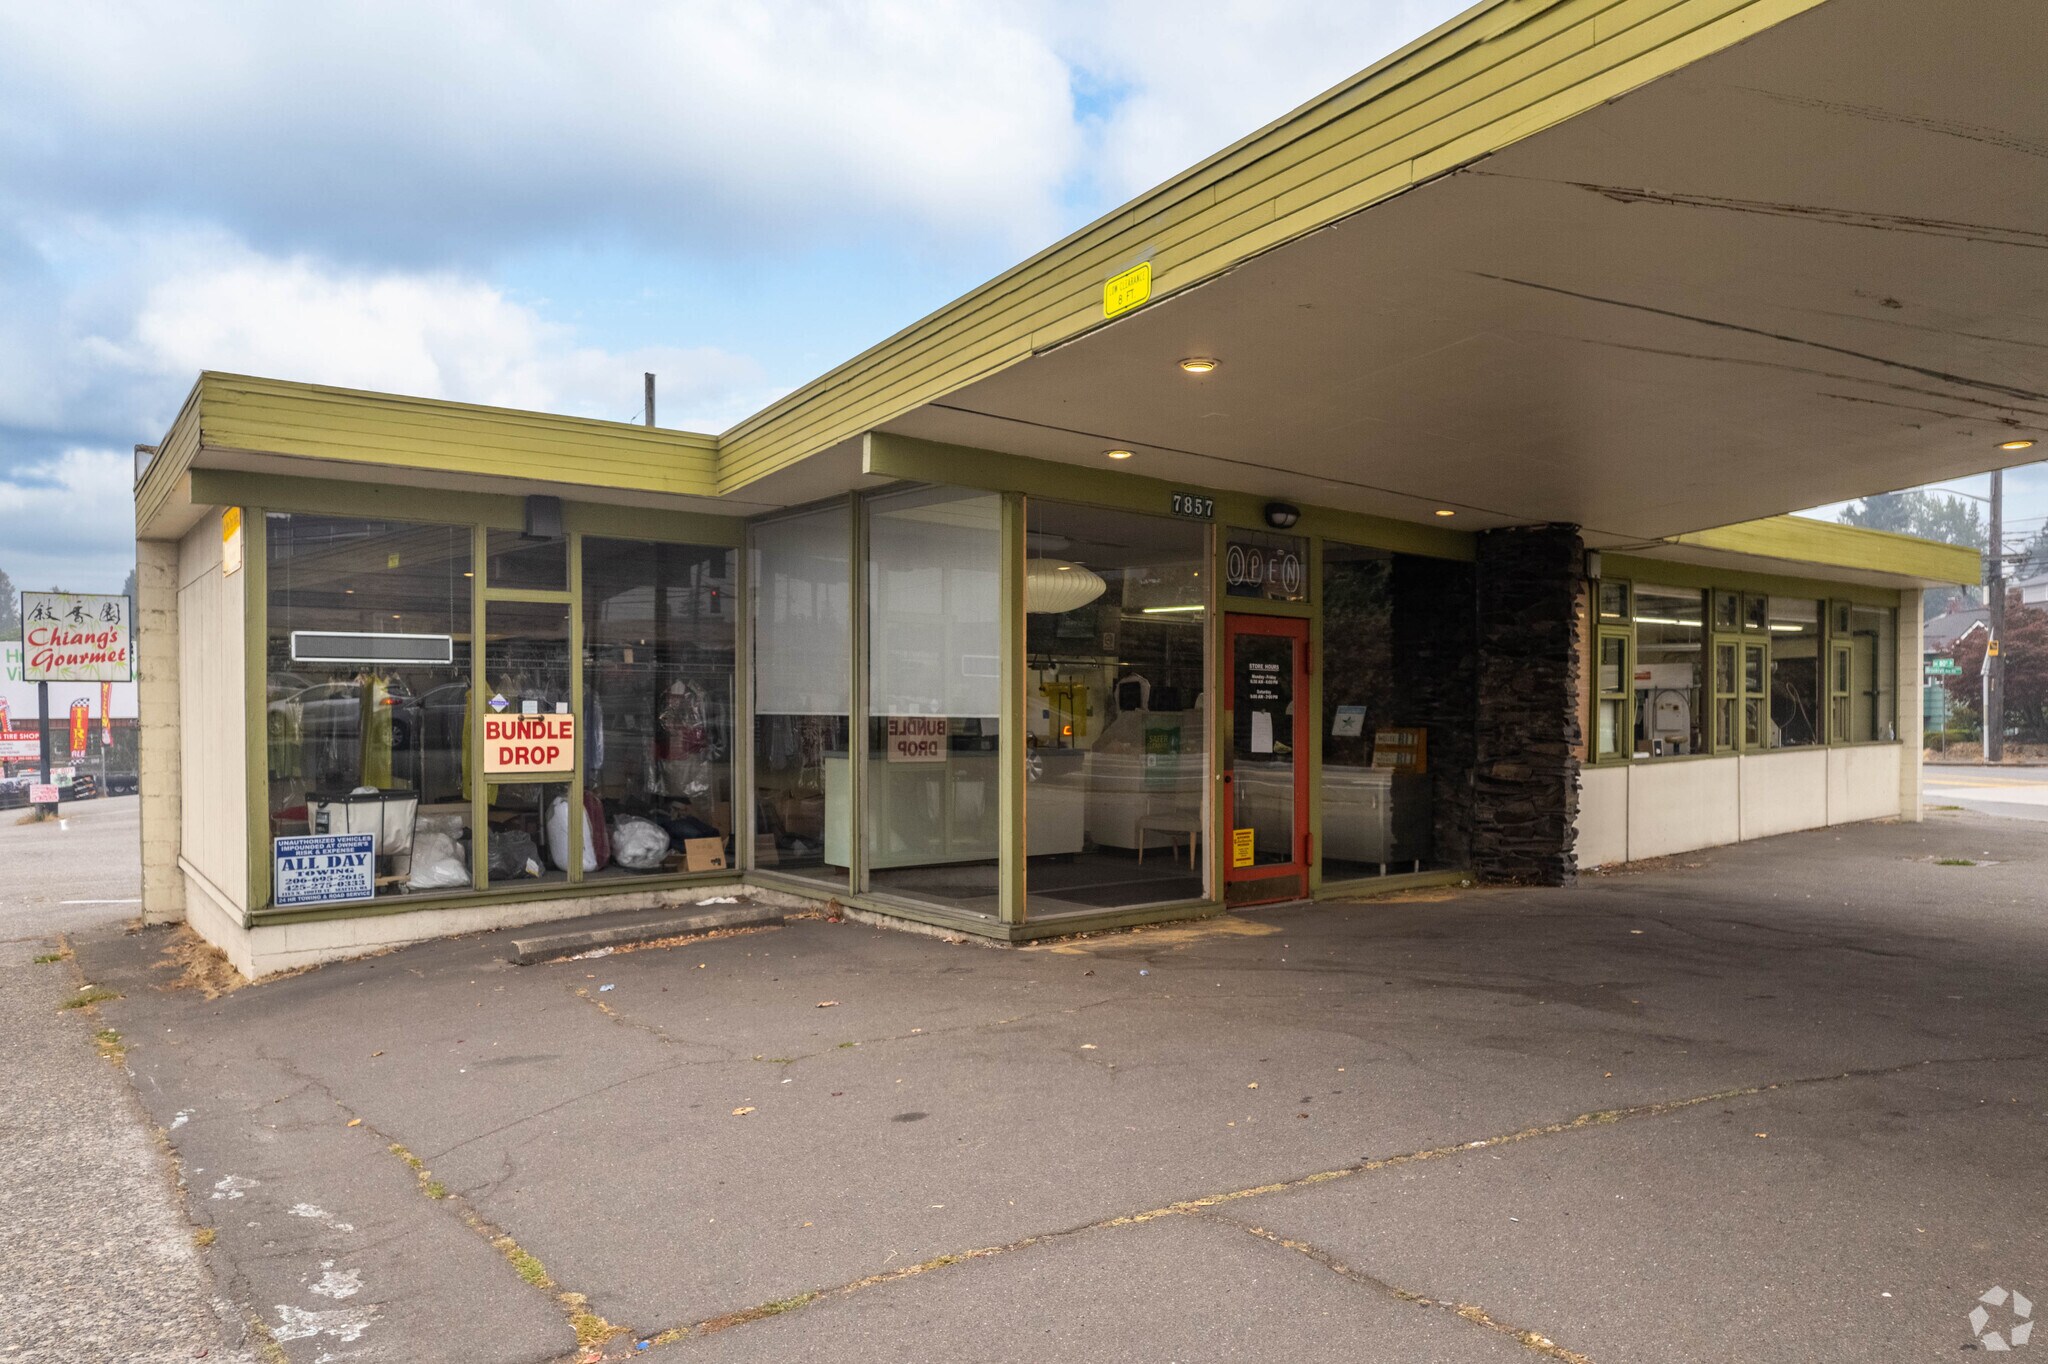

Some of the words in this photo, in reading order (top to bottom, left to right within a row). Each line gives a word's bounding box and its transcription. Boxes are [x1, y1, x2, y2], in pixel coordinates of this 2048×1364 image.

[1173, 494, 1213, 517] 7857
[1228, 549, 1298, 590] OPEN
[28, 625, 118, 650] Chiang's
[31, 648, 126, 673] Gourmet
[486, 721, 572, 740] BUNDLE
[499, 746, 560, 765] DROP
[278, 837, 335, 846] UNAUTHORIZED
[337, 836, 371, 844] VEHICLES
[281, 844, 325, 852] IMPOUNDED
[322, 847, 355, 855] EXPENSE
[282, 857, 319, 871] ALL
[327, 854, 367, 868] DAY
[285, 873, 365, 885] 206-695-2615
[296, 868, 354, 877] TOWING
[284, 880, 365, 891] 425-275-0333
[298, 894, 321, 902] TOWING
